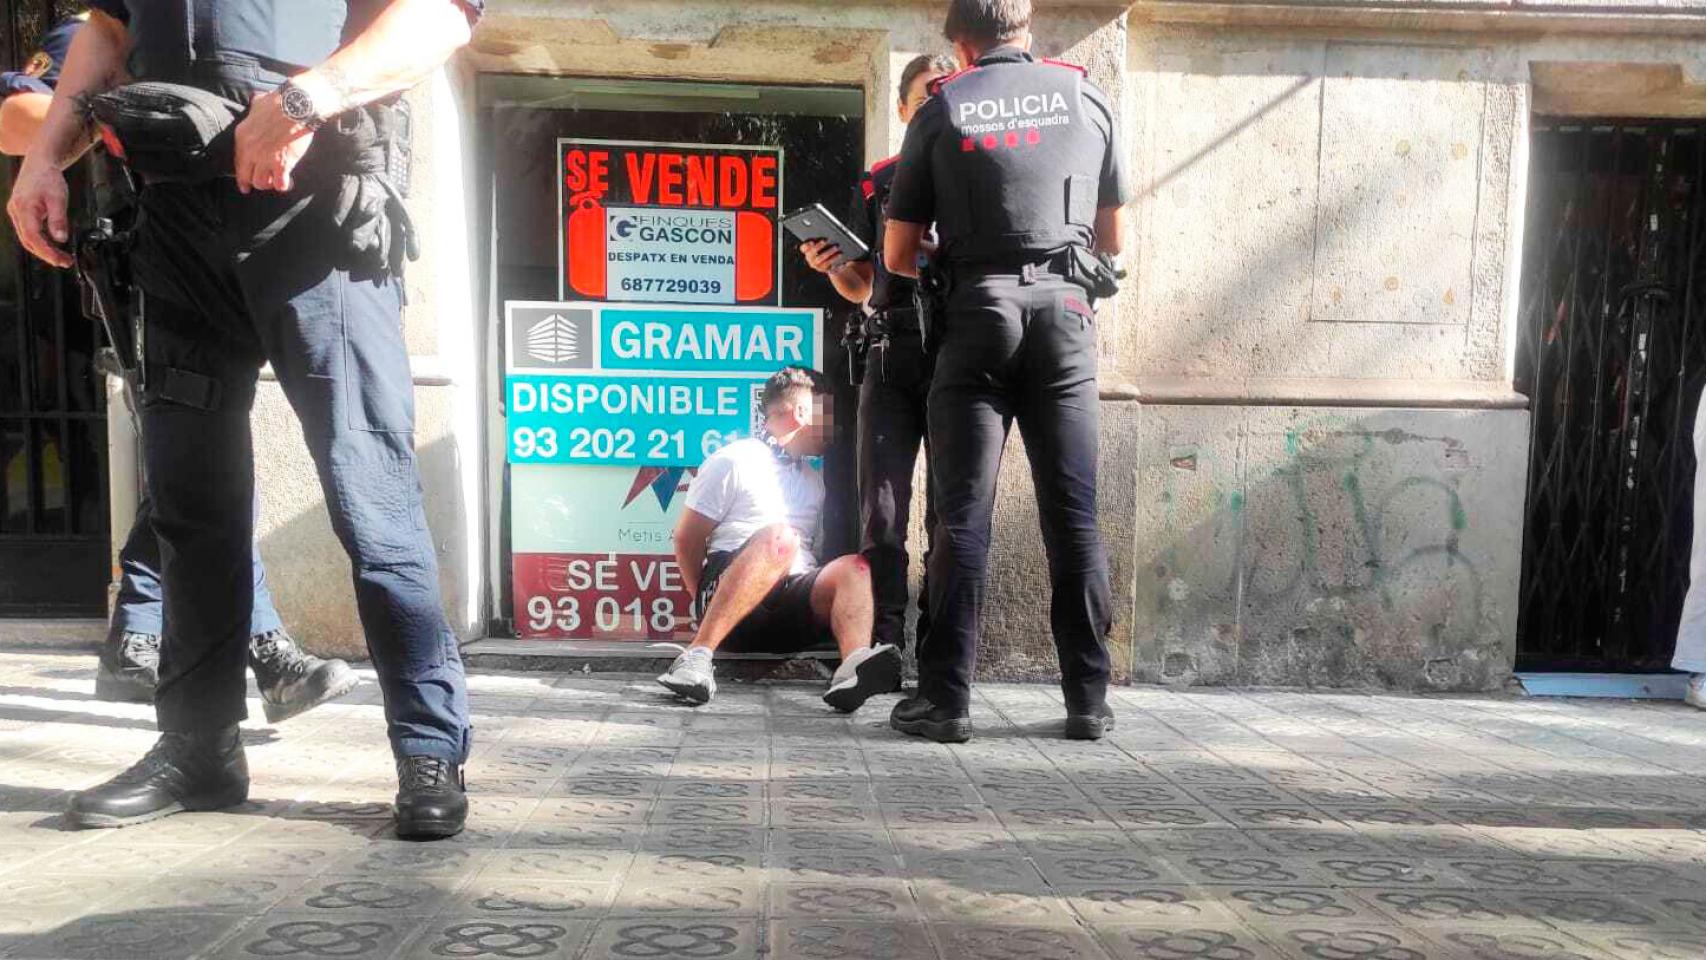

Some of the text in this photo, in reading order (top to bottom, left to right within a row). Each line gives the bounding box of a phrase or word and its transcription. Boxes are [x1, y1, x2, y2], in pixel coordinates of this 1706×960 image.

[959, 92, 1068, 122] POLICIA
[961, 113, 1070, 136] mossos d'esquadra
[567, 150, 776, 208] SE VENDE
[638, 215, 732, 228] FINQUES
[639, 227, 732, 244] GASCON
[608, 252, 735, 265] DESPATX EN VENDA
[621, 277, 721, 294] 687729039
[611, 321, 804, 361] GRAMAR
[512, 383, 739, 416] DISPONIBLE
[513, 427, 558, 458] 93
[569, 428, 636, 459] 202
[648, 429, 685, 459] 21
[527, 596, 581, 631] 93
[594, 597, 675, 632] 018
